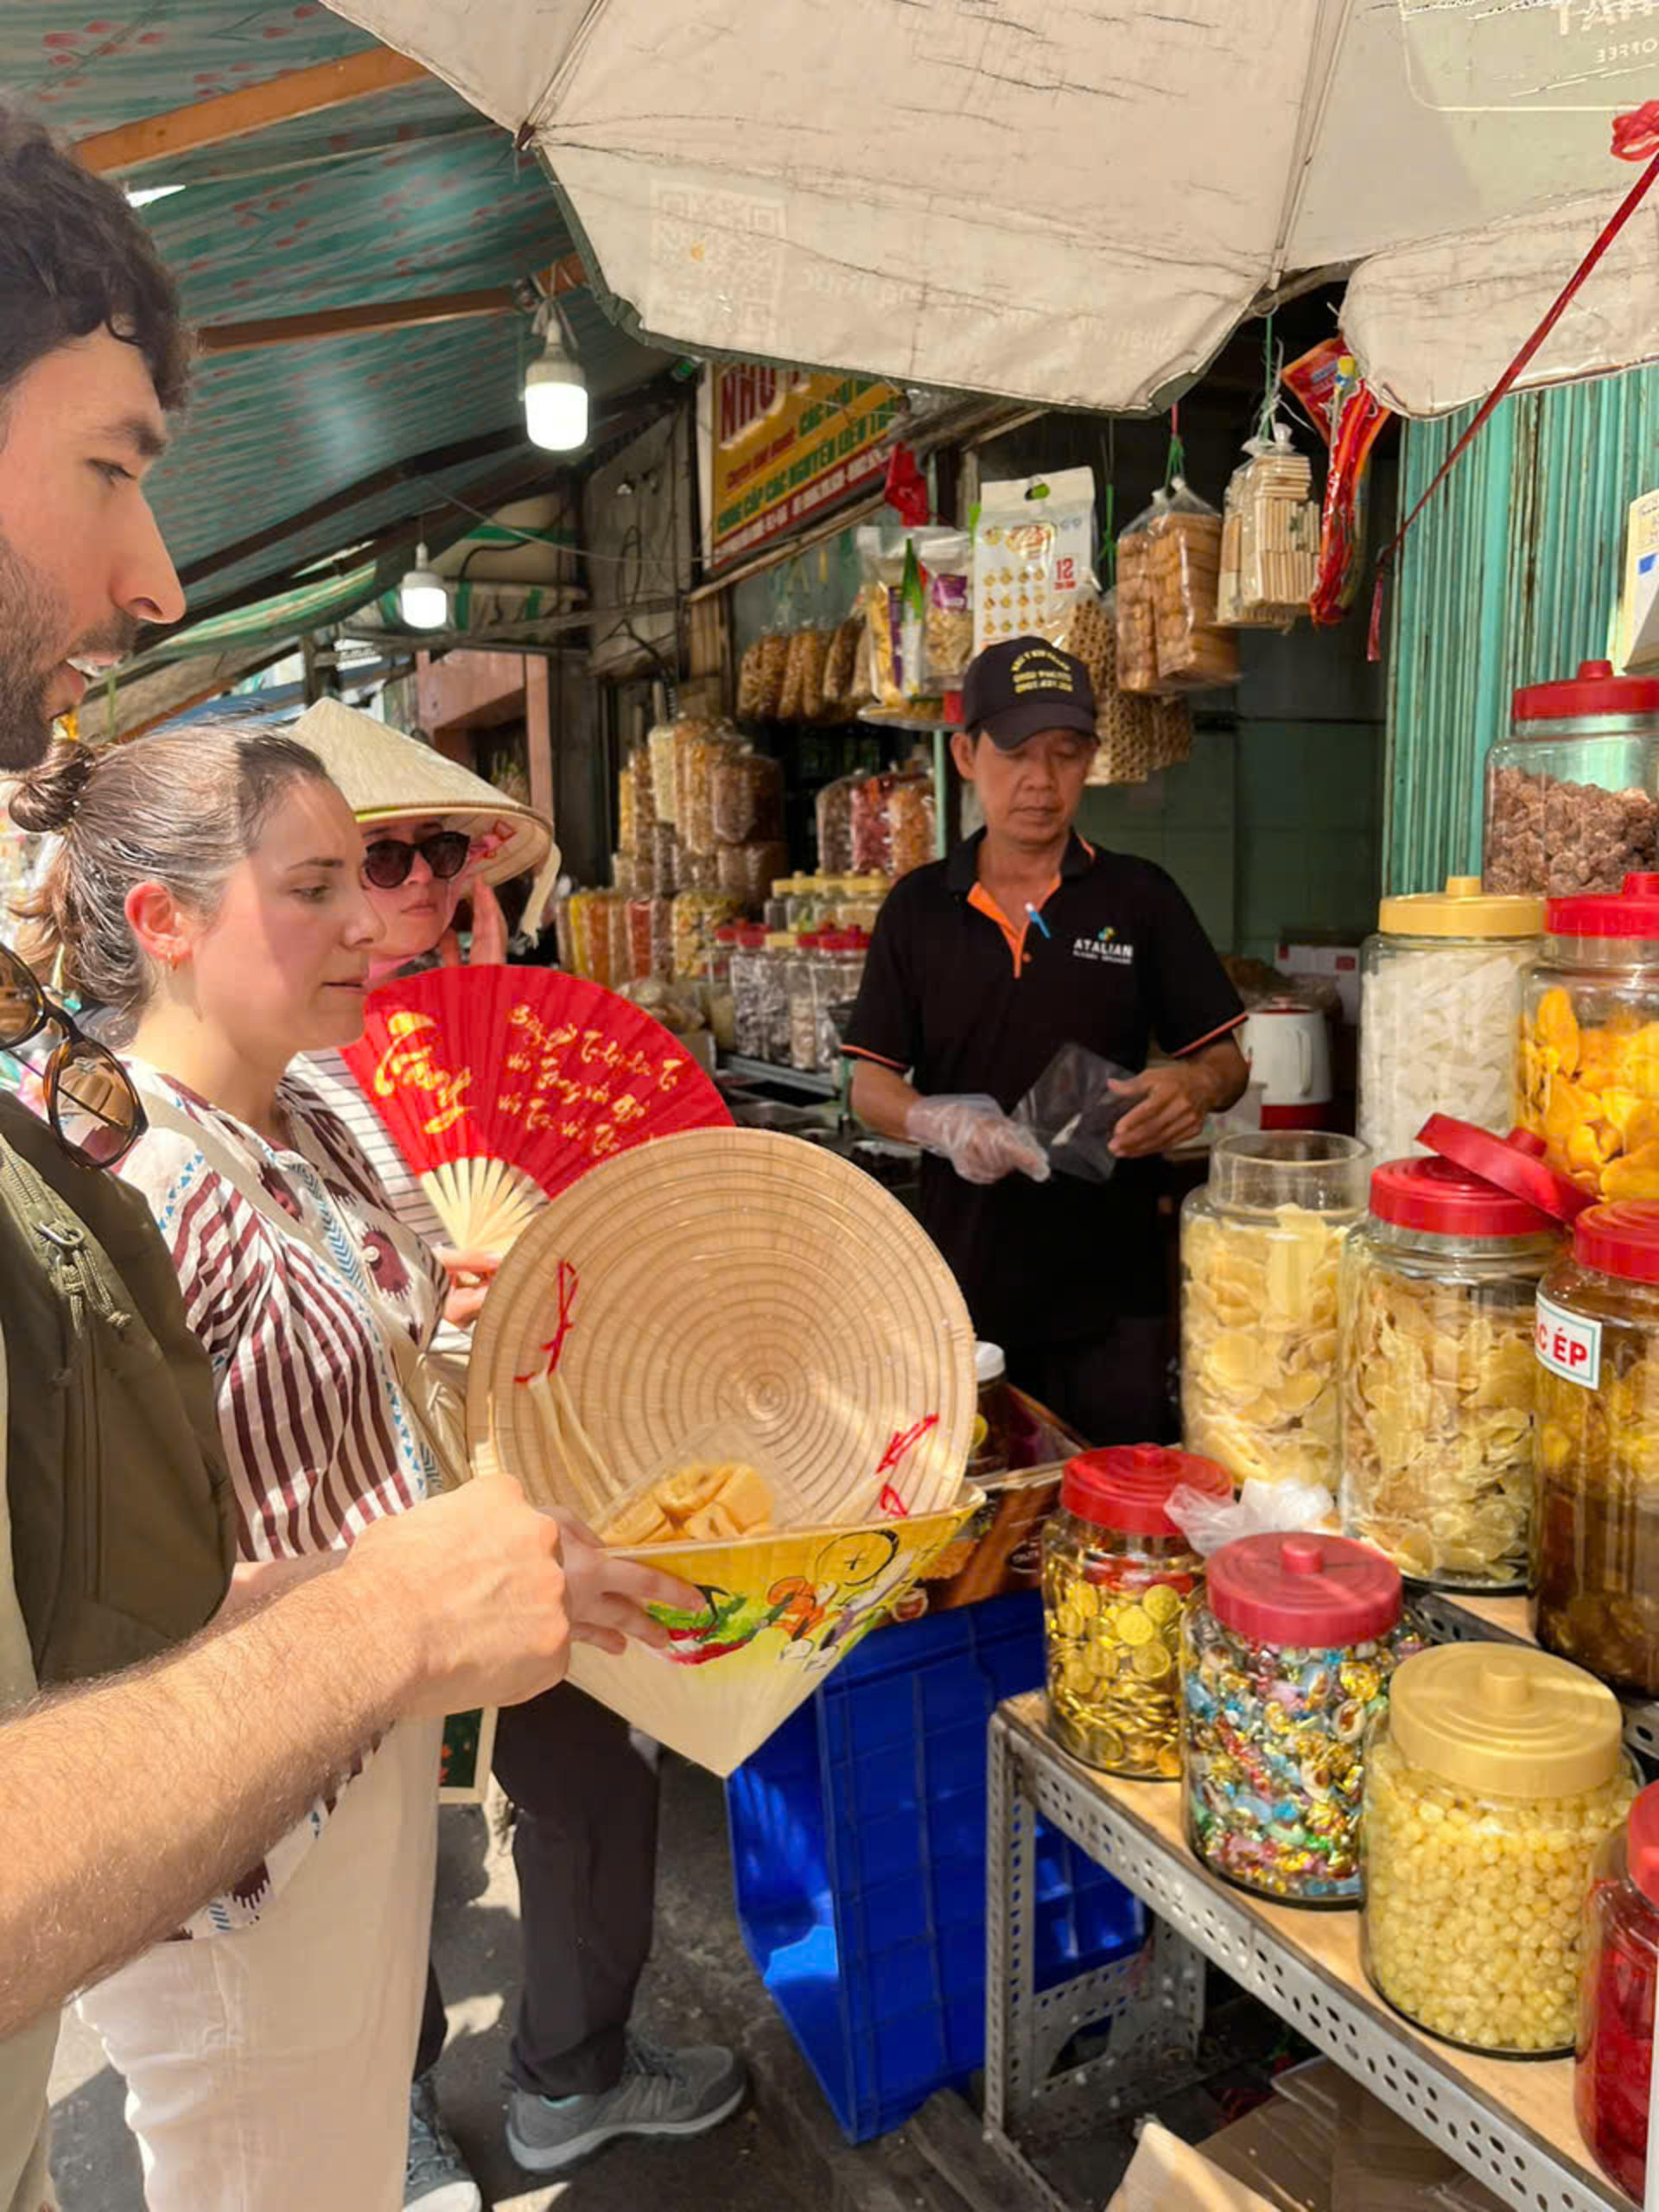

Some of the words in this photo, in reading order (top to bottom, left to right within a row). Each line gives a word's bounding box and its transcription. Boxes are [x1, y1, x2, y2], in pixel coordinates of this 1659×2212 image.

[1055, 557, 1074, 581] 12
[1074, 939, 1133, 957] ATALIAN
[1554, 1328, 1587, 1366] ÉP
